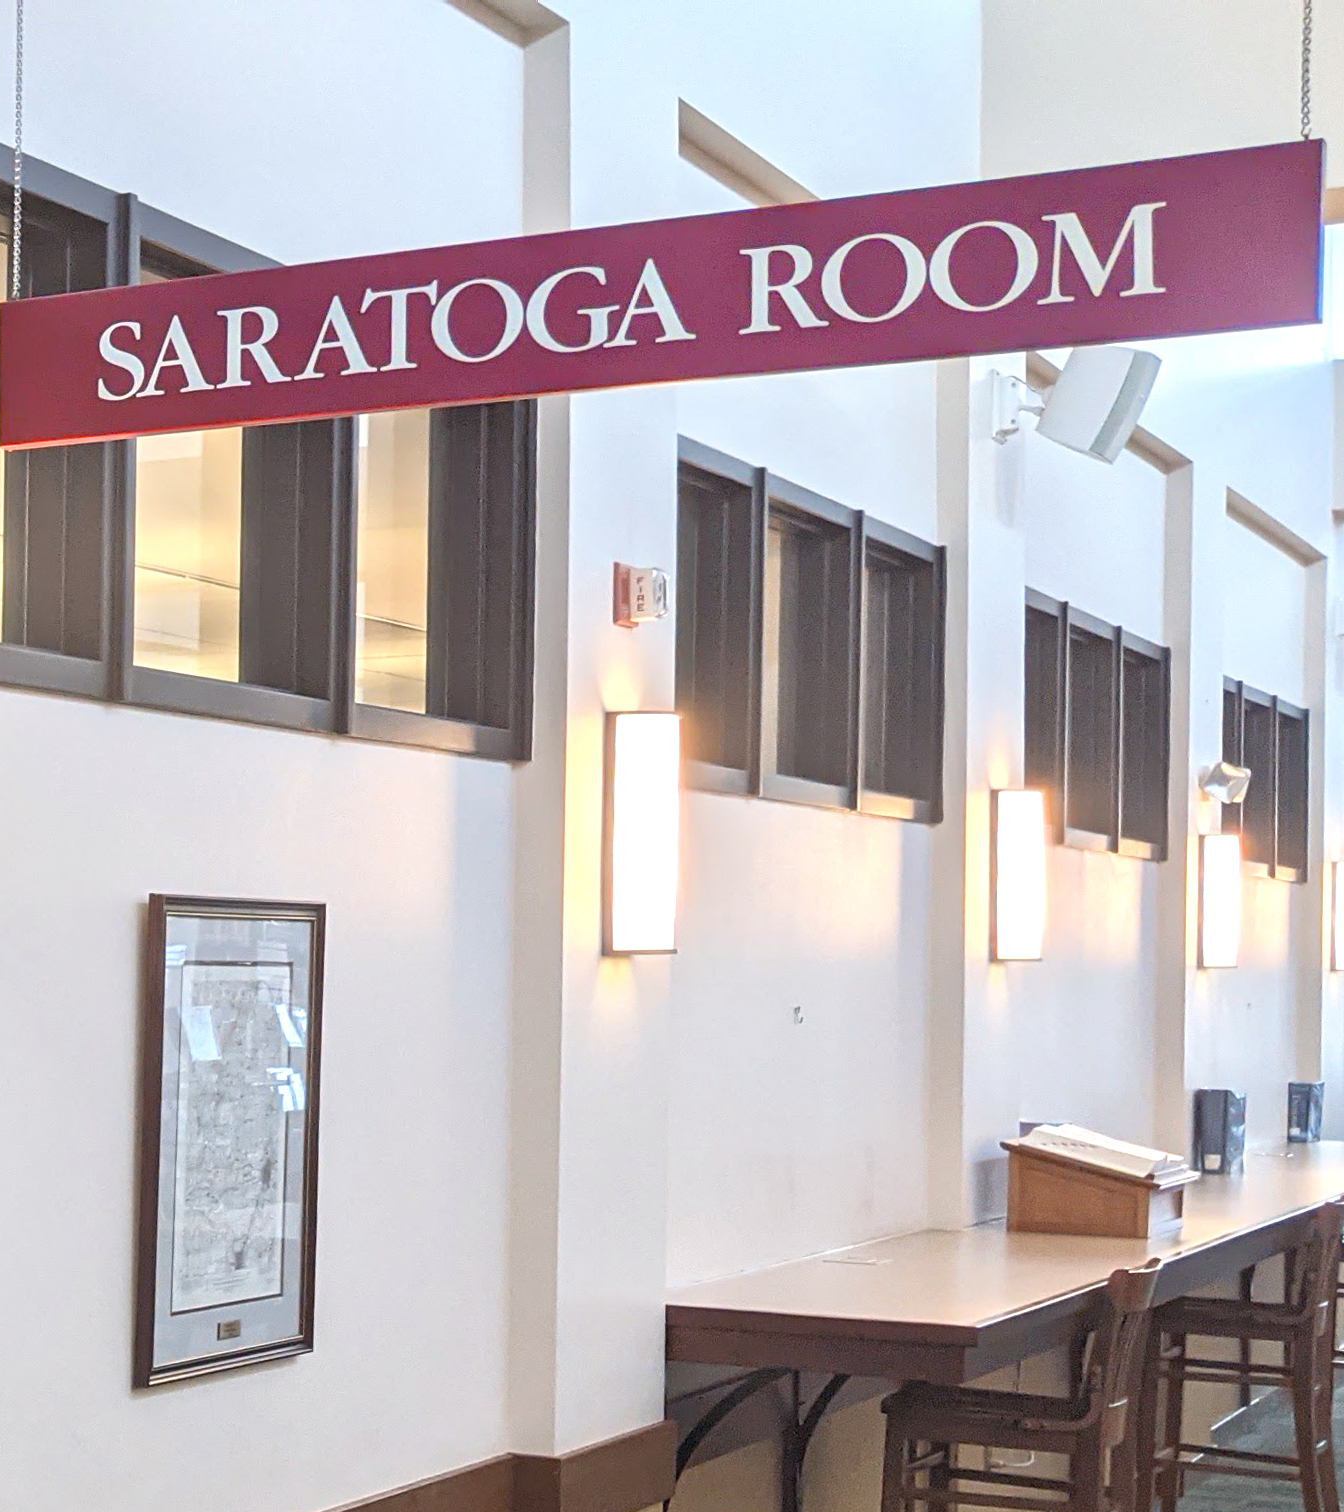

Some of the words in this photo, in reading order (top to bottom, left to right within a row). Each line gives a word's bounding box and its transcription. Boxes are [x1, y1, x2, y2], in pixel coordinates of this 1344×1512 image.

[97, 257, 694, 403] SARATOGA
[738, 200, 1167, 335] ROOM
[637, 576, 645, 612] FIRE
